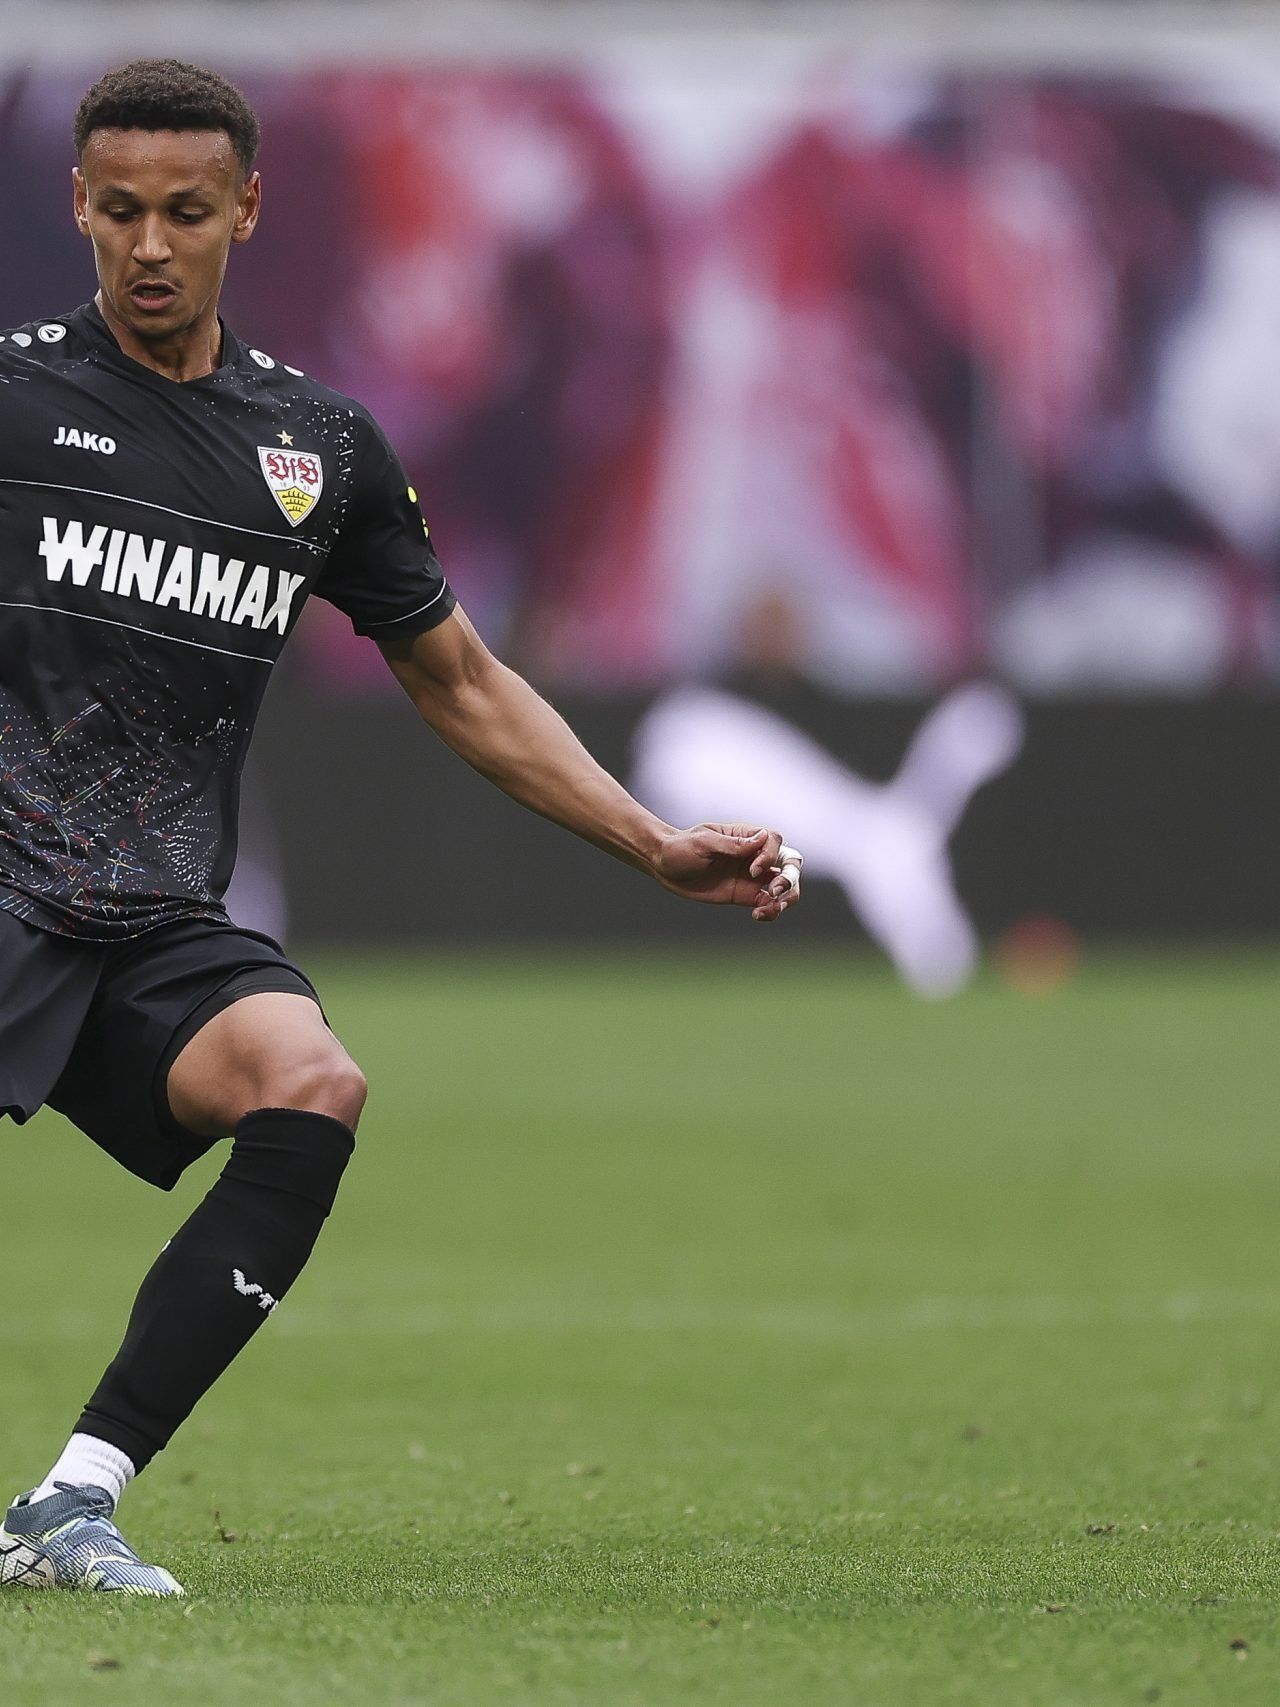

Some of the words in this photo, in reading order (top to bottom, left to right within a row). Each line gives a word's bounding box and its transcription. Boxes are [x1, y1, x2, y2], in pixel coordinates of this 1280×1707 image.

[53, 426, 117, 455] JAKO
[266, 453, 319, 485] VfB
[38, 516, 306, 636] WINAMAX
[232, 1268, 279, 1316] Vf
